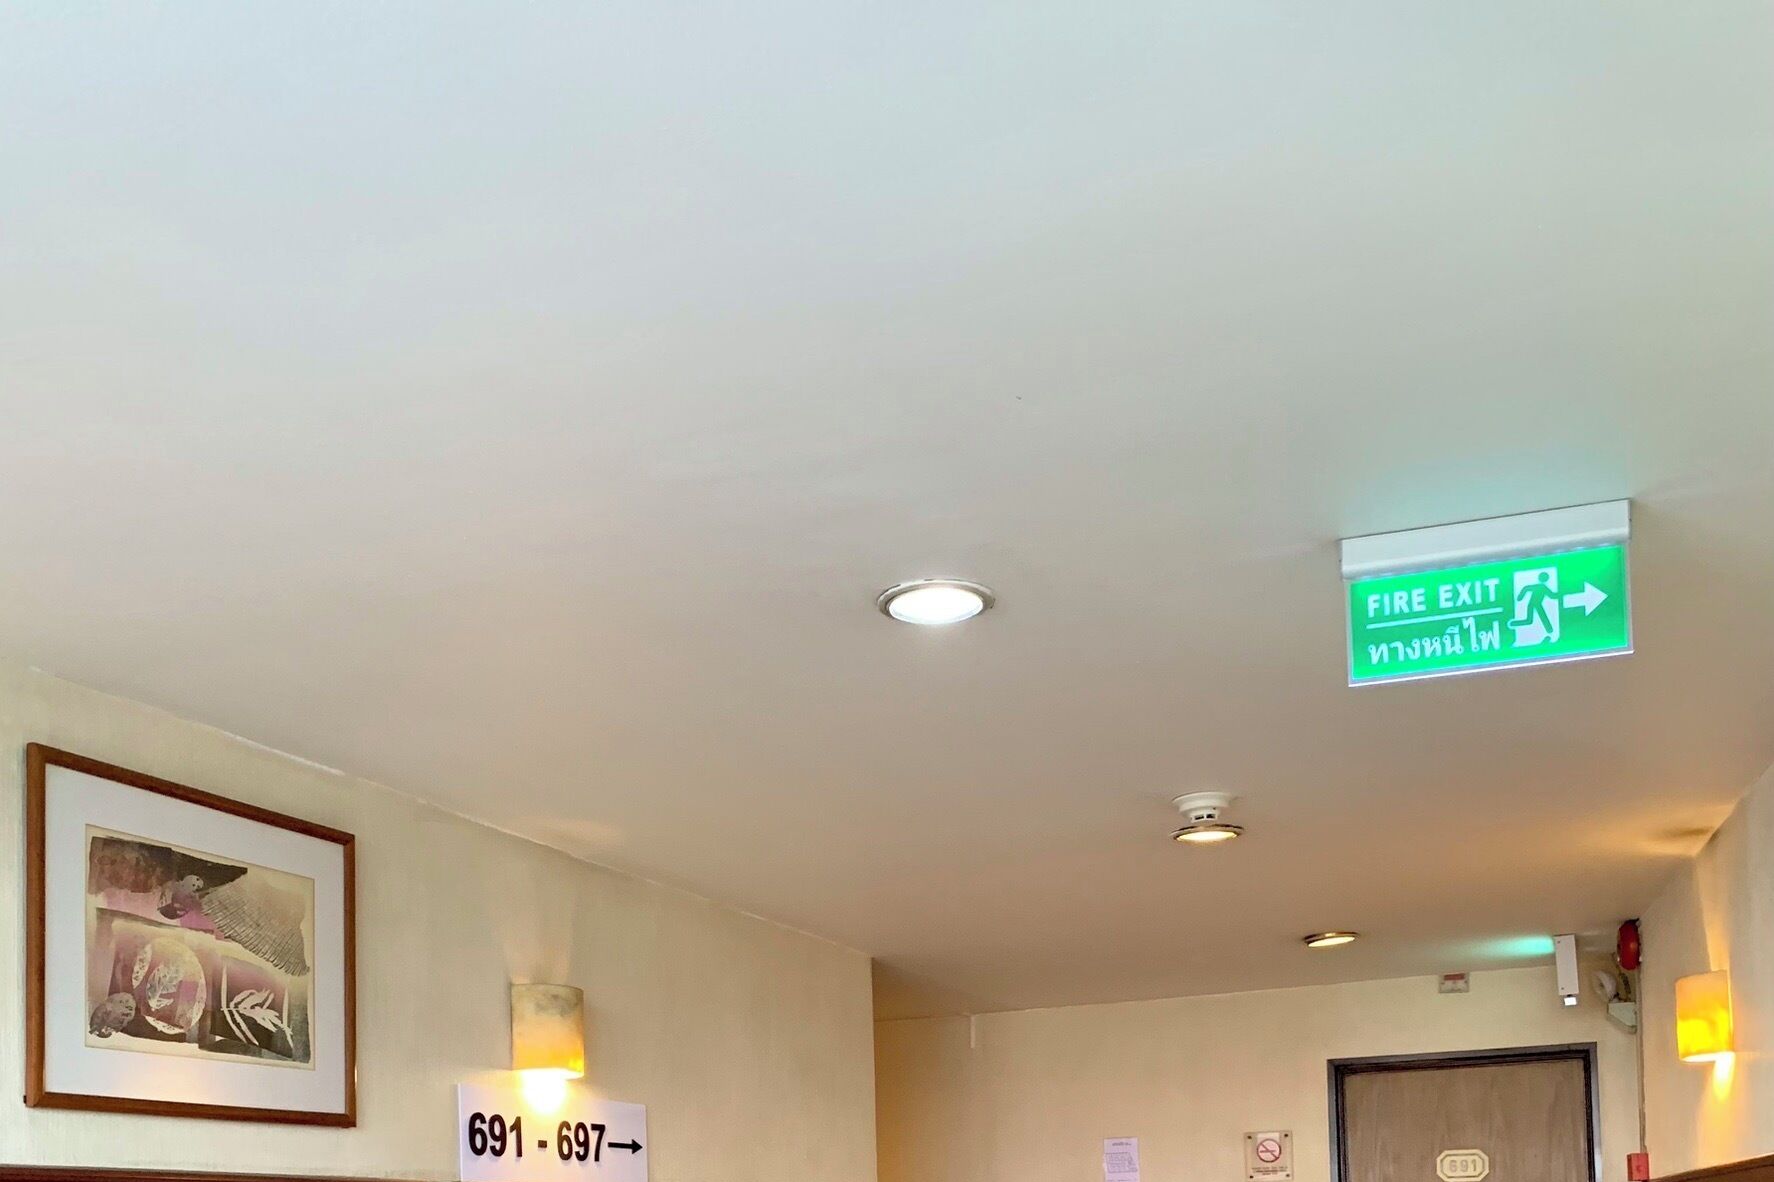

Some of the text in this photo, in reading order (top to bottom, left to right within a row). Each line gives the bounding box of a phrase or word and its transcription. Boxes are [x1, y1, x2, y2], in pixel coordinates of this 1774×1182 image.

[1367, 578, 1500, 618] FIRE EXIT
[1368, 617, 1500, 665] ทางหนีไฟ
[468, 1112, 523, 1158] 691
[557, 1120, 606, 1162] 697
[1449, 1159, 1477, 1173] 691
